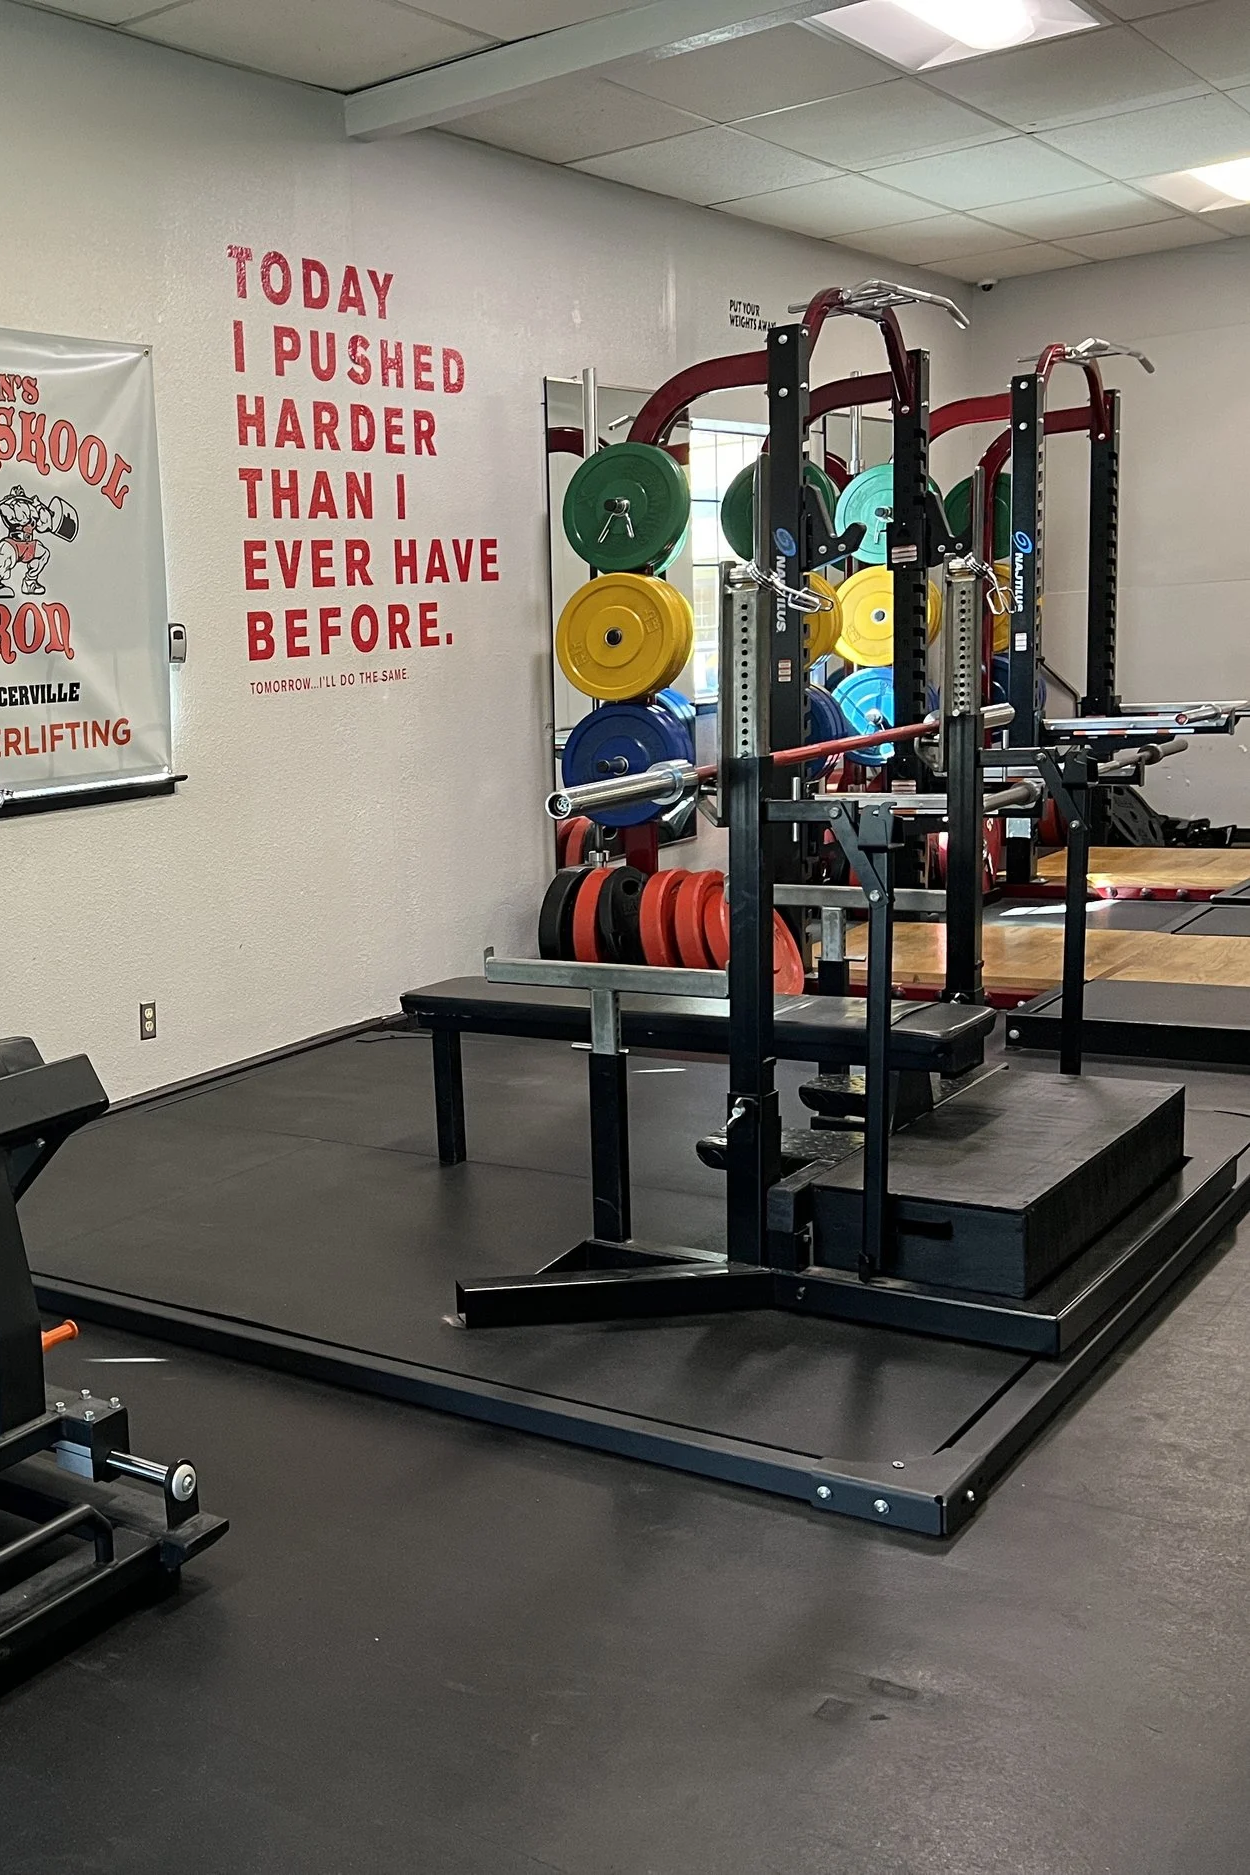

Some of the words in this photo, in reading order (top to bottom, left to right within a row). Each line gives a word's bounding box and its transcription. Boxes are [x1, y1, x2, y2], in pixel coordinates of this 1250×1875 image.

[226, 244, 395, 320] TODAY
[729, 299, 743, 313] PUT
[742, 302, 760, 317] YOUR
[729, 313, 757, 331] WEIGHTS
[232, 319, 246, 373] I
[273, 325, 466, 394] PUSHED
[236, 394, 438, 457] HARDER
[238, 467, 374, 520] THAN
[396, 473, 406, 520] I
[243, 539, 375, 591] EVER
[394, 538, 501, 584] HAVE
[775, 555, 788, 633] NAILUS
[246, 601, 454, 662] BEFORE.
[340, 673, 355, 686] DO
[359, 671, 378, 684] THE
[381, 667, 410, 682] SAME.
